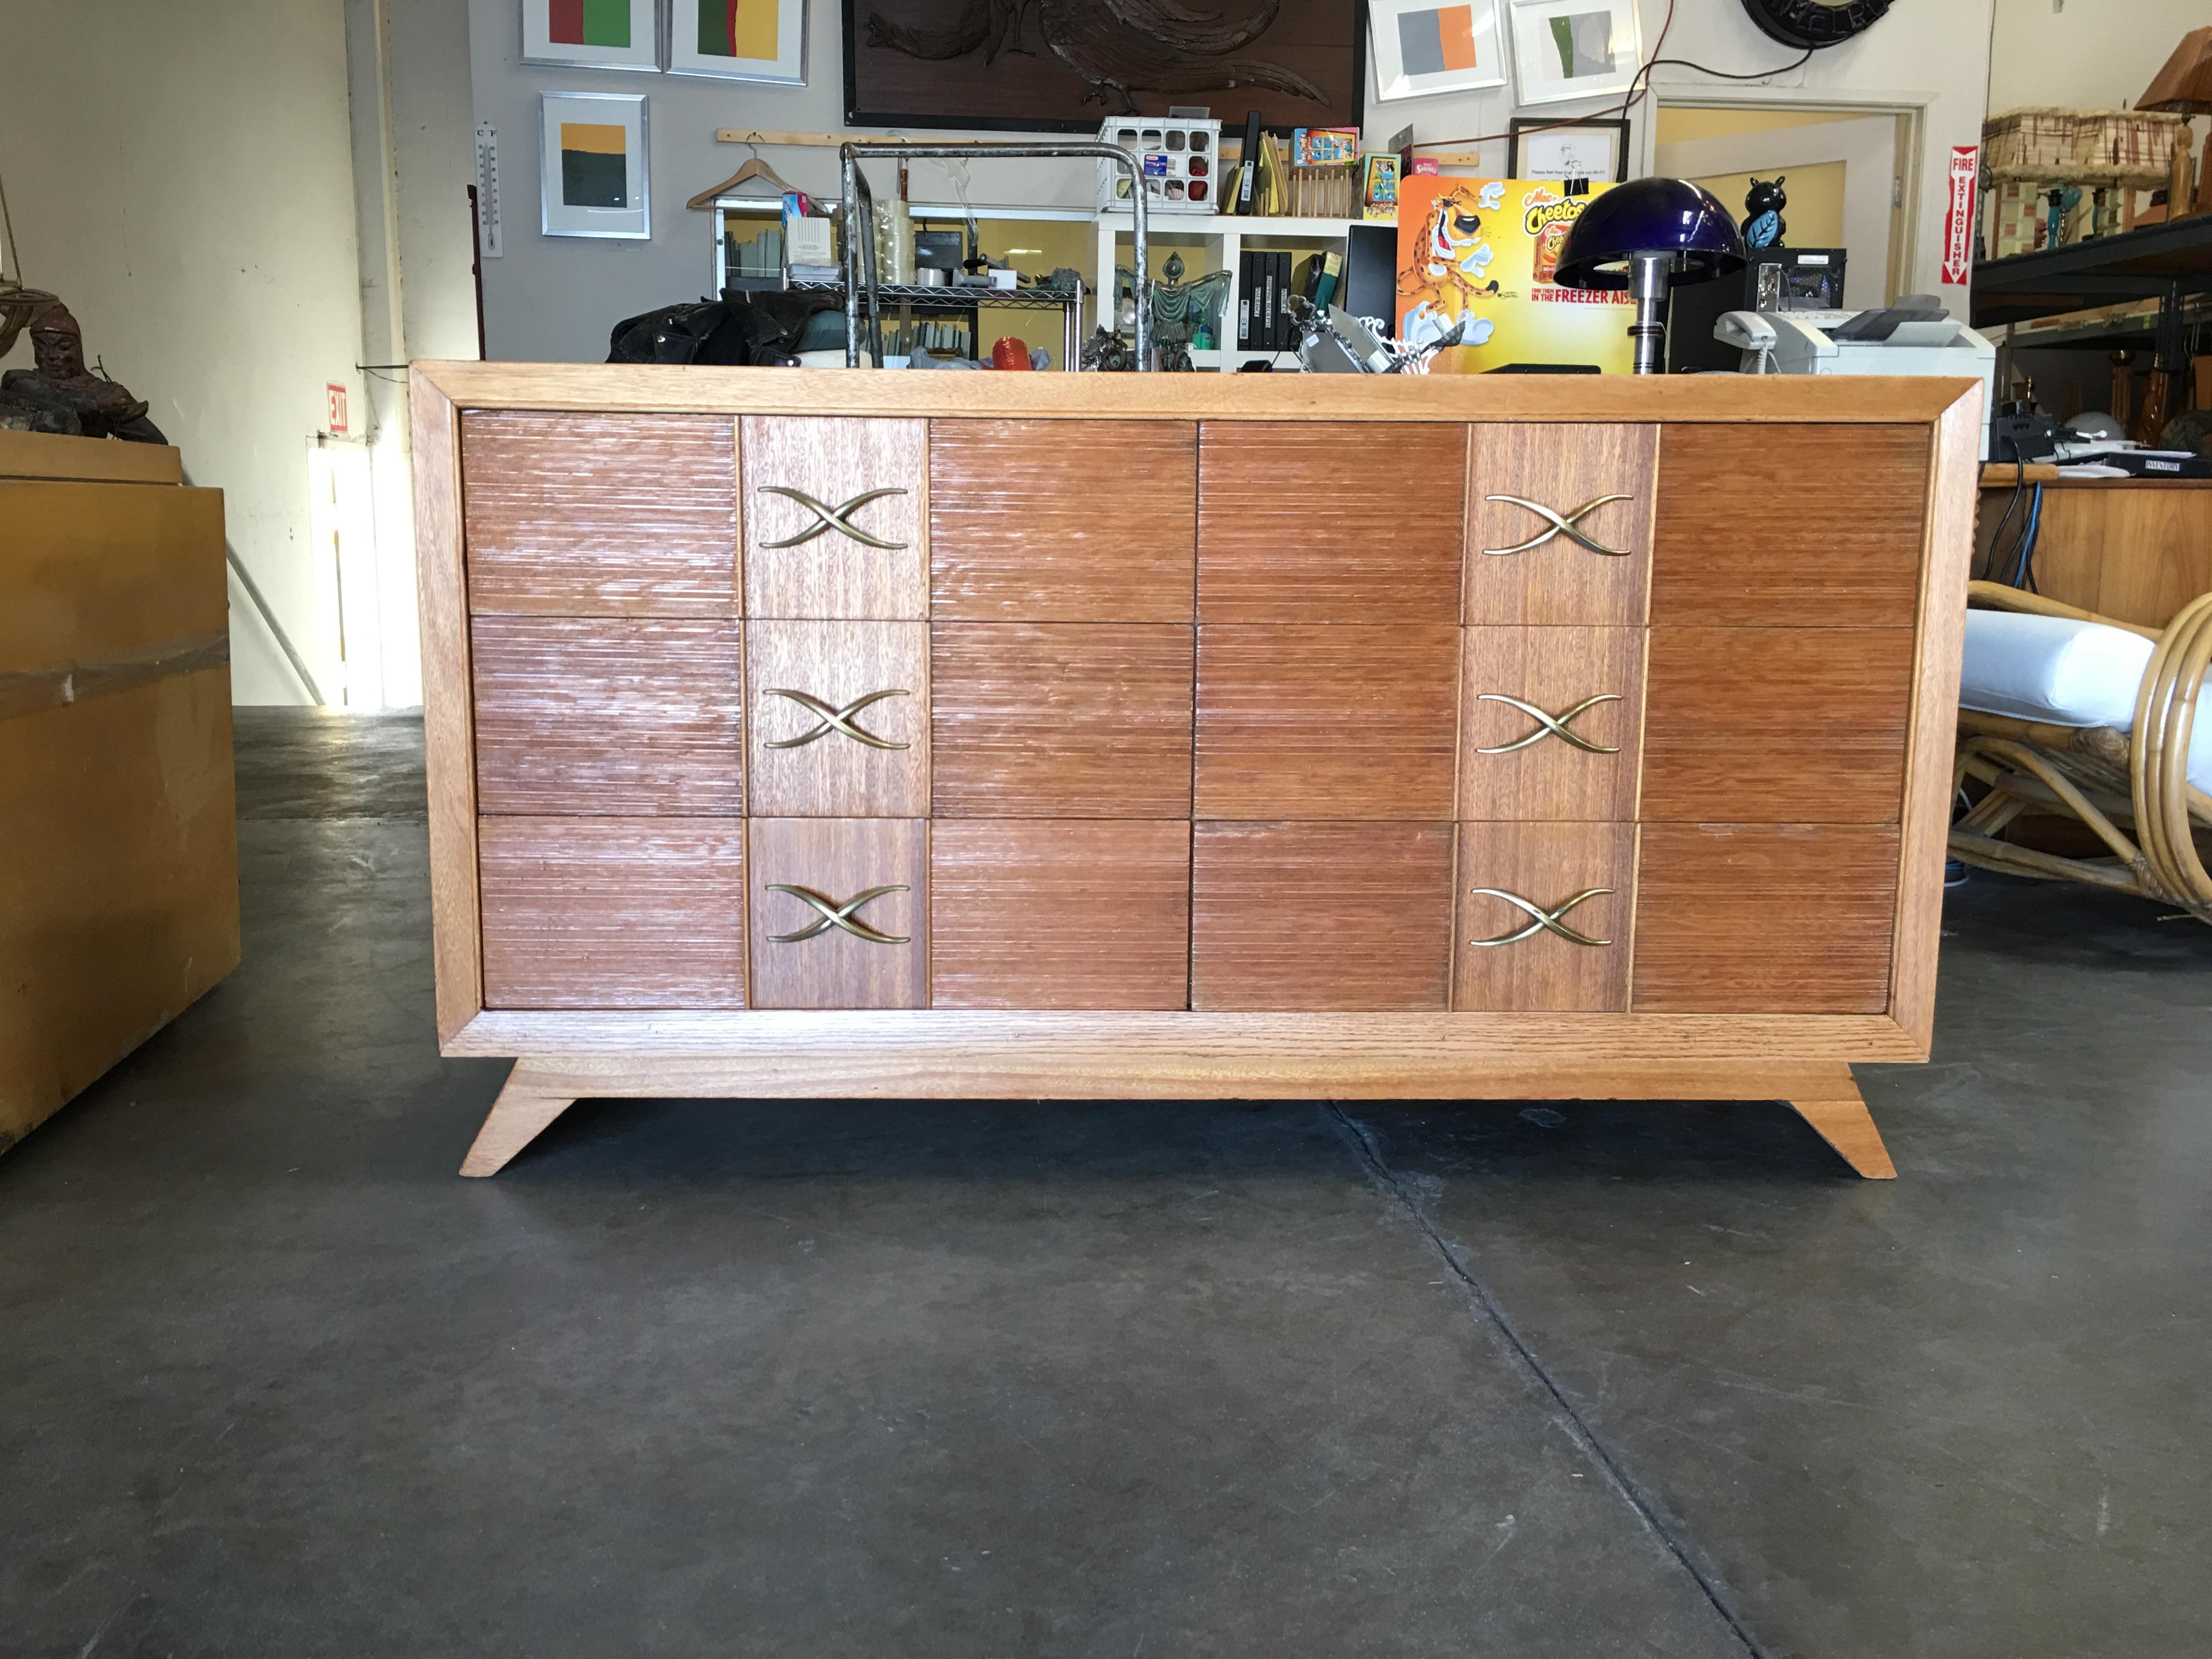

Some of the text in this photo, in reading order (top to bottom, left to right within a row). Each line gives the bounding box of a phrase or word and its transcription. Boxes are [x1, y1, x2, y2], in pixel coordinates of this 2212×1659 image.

[1953, 158, 1973, 171] FIRE
[1525, 198, 1586, 235] Cheetos
[1952, 176, 1966, 275] EXTINGUISHER
[1555, 289, 1609, 303] FREEZER
[329, 390, 347, 427] EXIT
